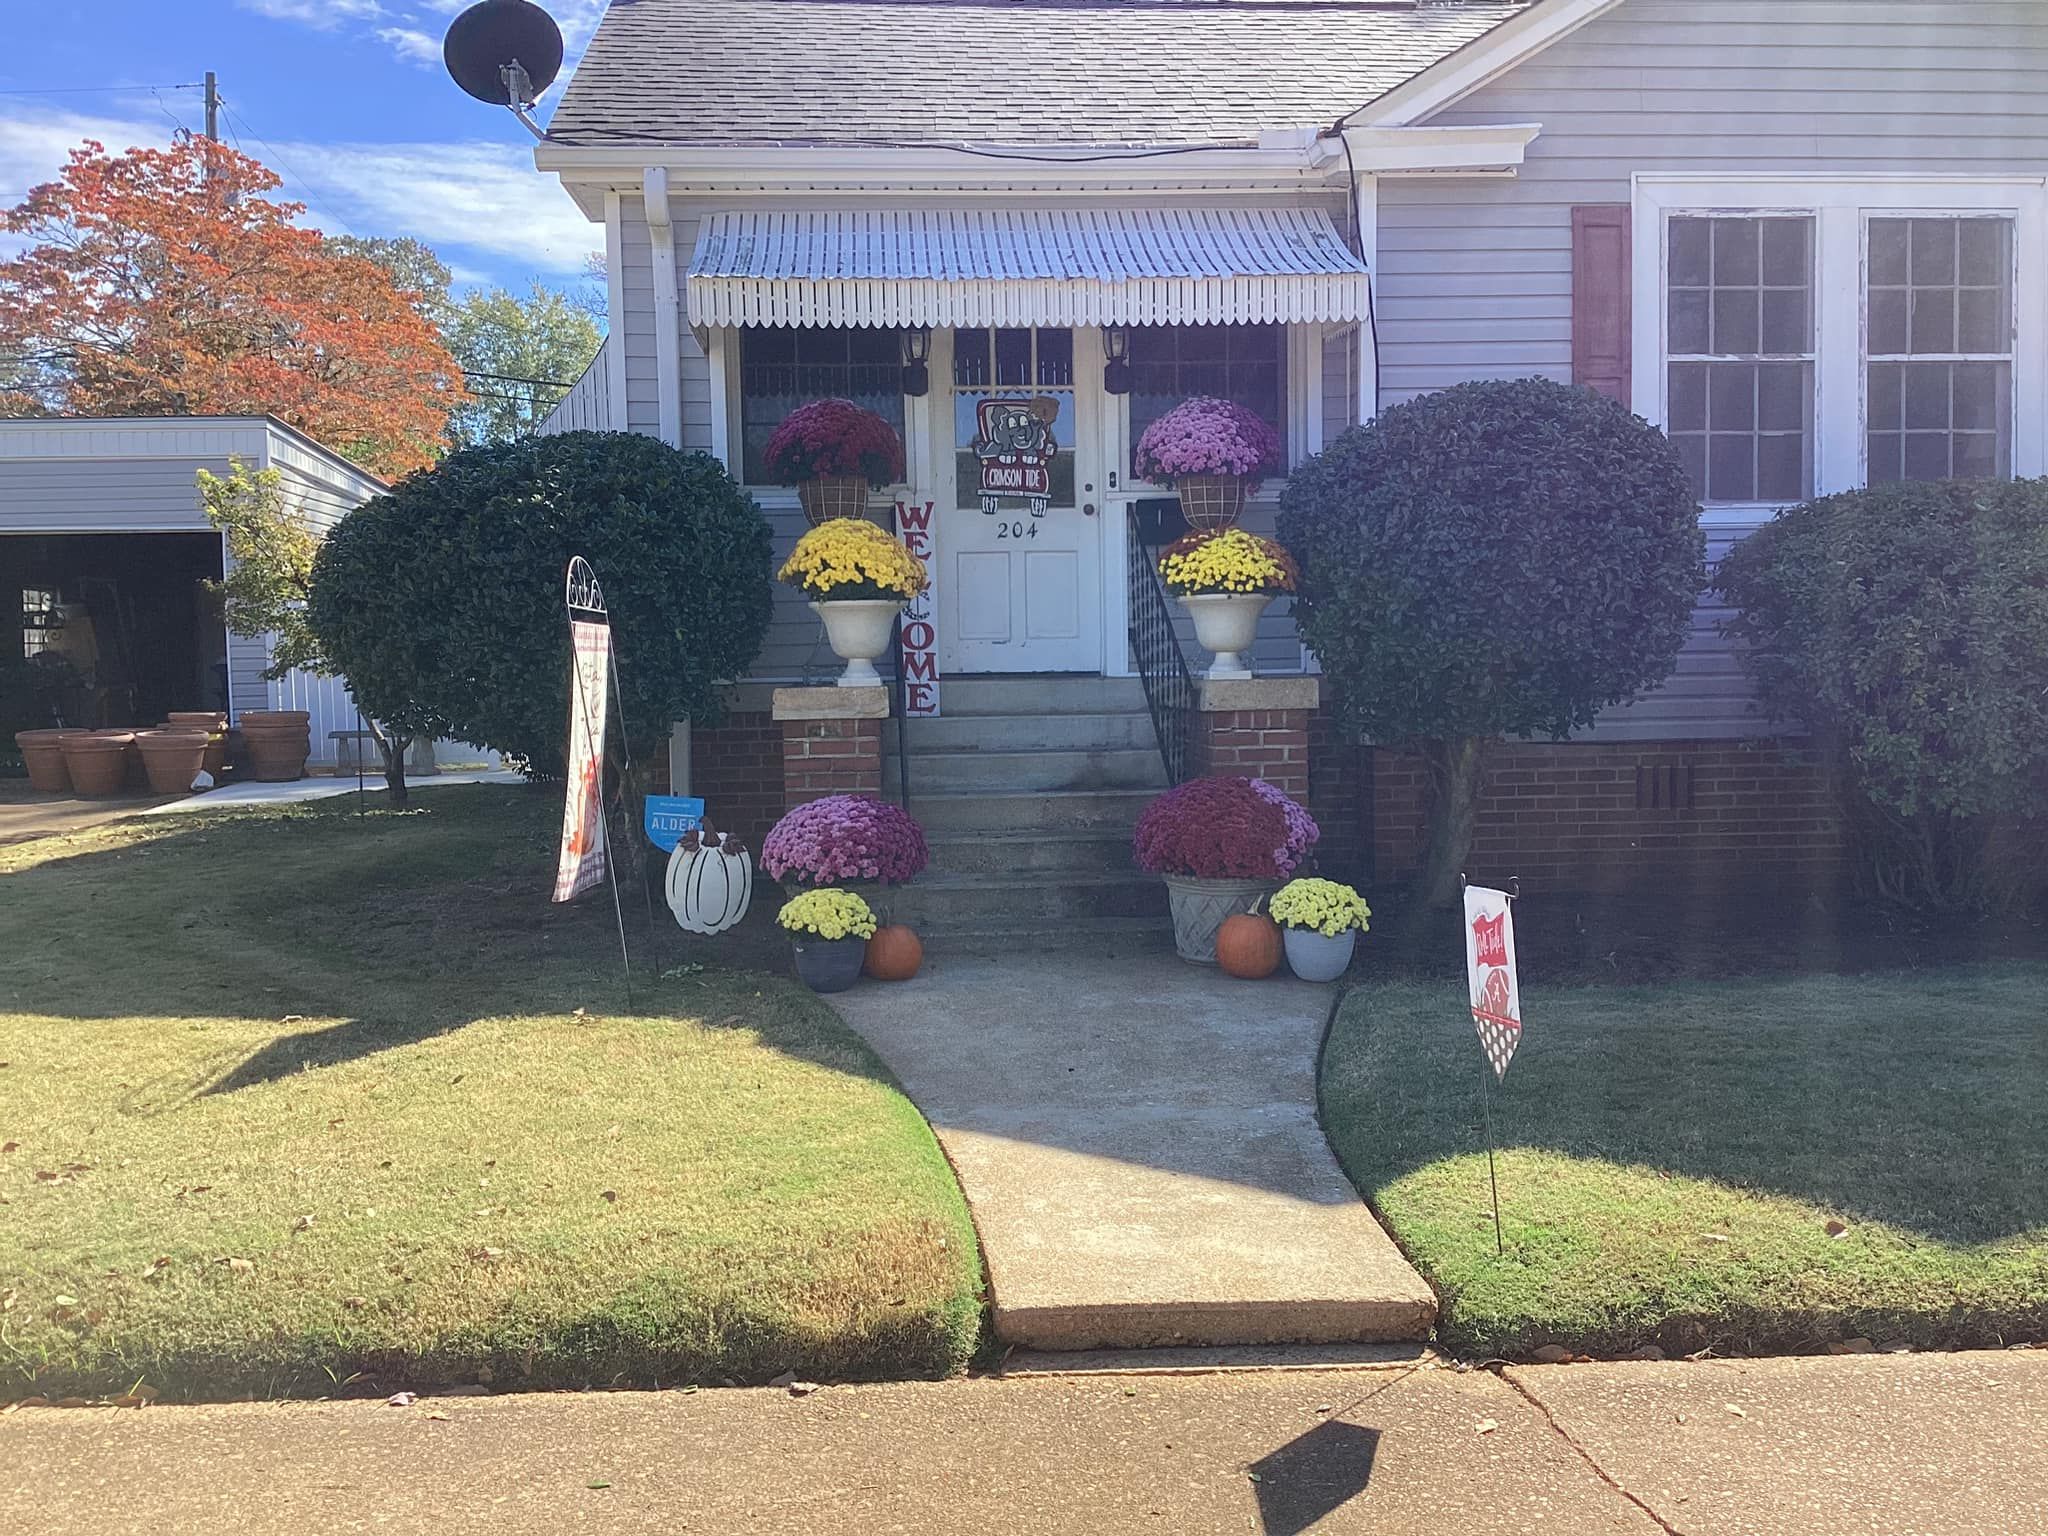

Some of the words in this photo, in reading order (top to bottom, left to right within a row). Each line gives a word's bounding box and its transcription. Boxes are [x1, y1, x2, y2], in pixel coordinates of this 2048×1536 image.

[989, 468, 1022, 487] CRIMSON
[1025, 469, 1040, 488] TIDE
[997, 521, 1038, 539] 204
[651, 817, 696, 832] ALDER
